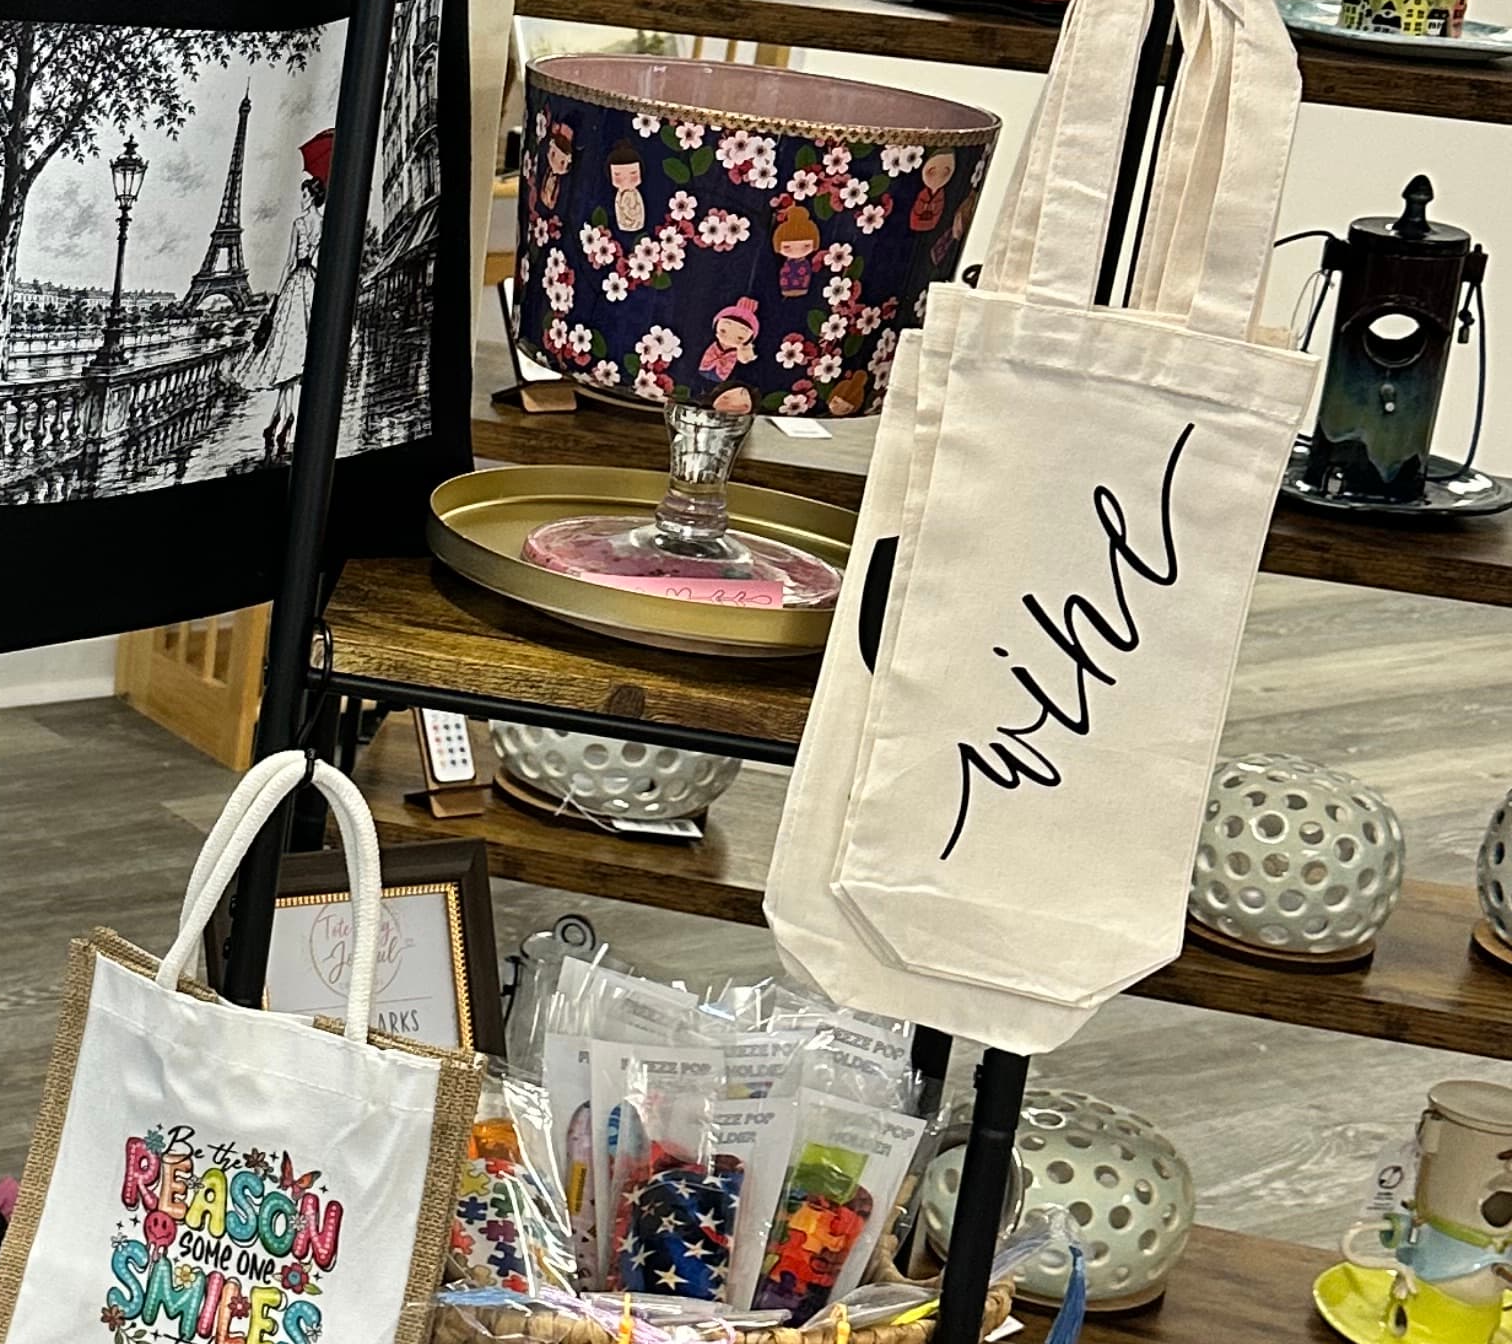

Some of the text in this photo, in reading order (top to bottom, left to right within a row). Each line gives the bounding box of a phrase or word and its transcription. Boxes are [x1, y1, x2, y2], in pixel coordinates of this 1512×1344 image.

[873, 1040, 905, 1060] POP
[681, 1062, 712, 1075] POP
[744, 1111, 776, 1125] POP
[162, 1125, 244, 1172] Be the
[121, 1136, 344, 1272] REASON
